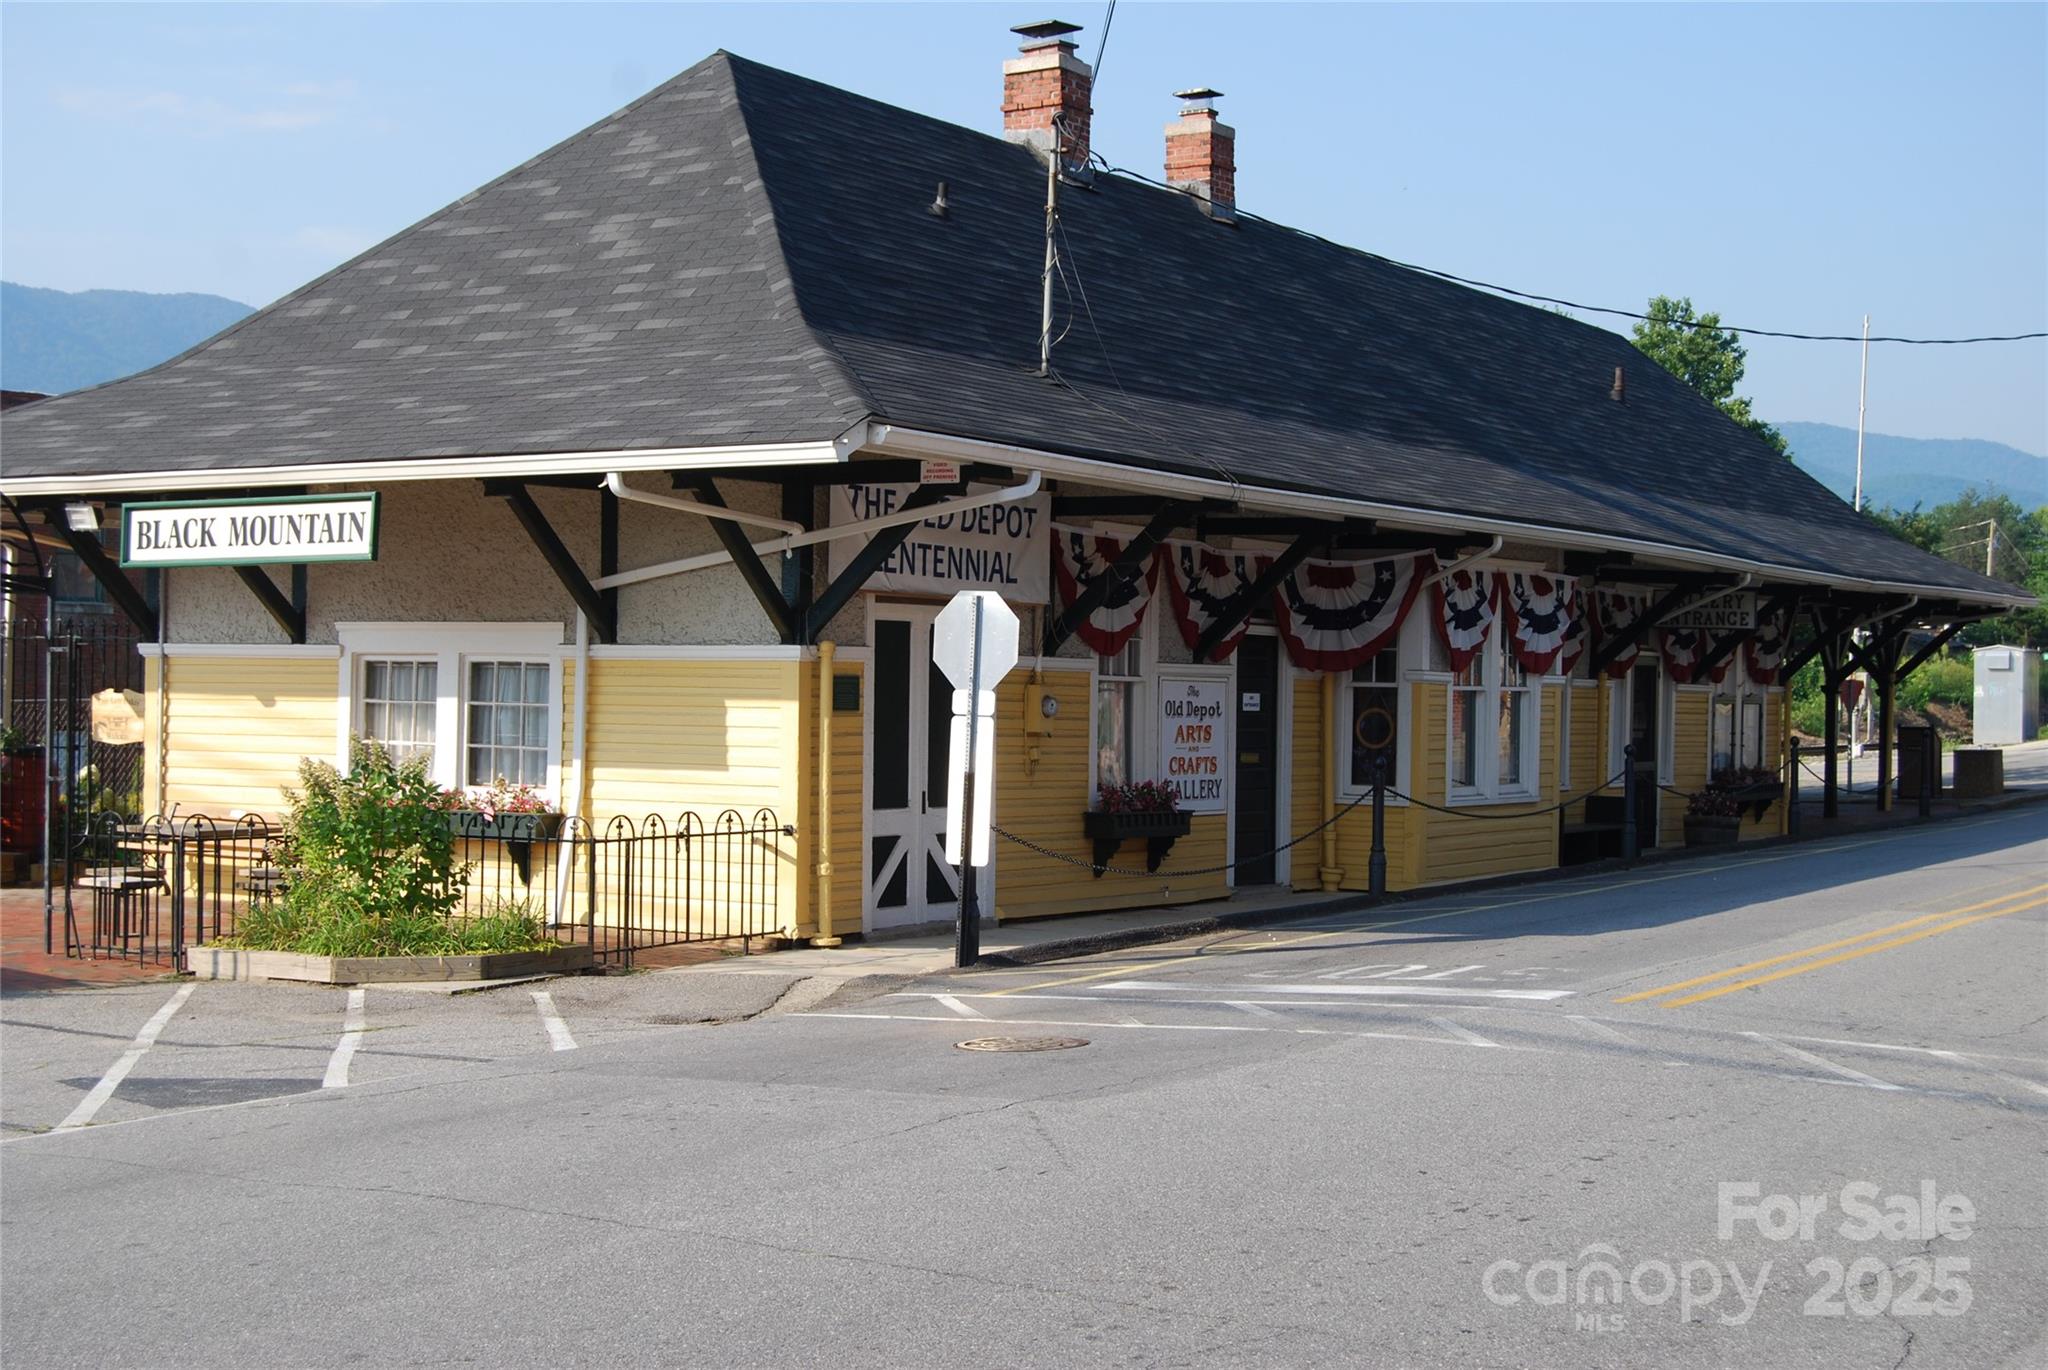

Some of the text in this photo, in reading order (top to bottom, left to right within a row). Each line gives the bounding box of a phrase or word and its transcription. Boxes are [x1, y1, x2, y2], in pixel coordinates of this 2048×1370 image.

[848, 484, 896, 520] THE
[961, 504, 1037, 538] DEPOT
[137, 511, 366, 549] BLACK MOUNTAIN
[878, 542, 1018, 584] ENTENNIAL
[1187, 685, 1200, 697] The
[1165, 700, 1222, 720] Old Depot
[1175, 725, 1212, 743] ARTS
[1169, 756, 1217, 775] CRAFTS
